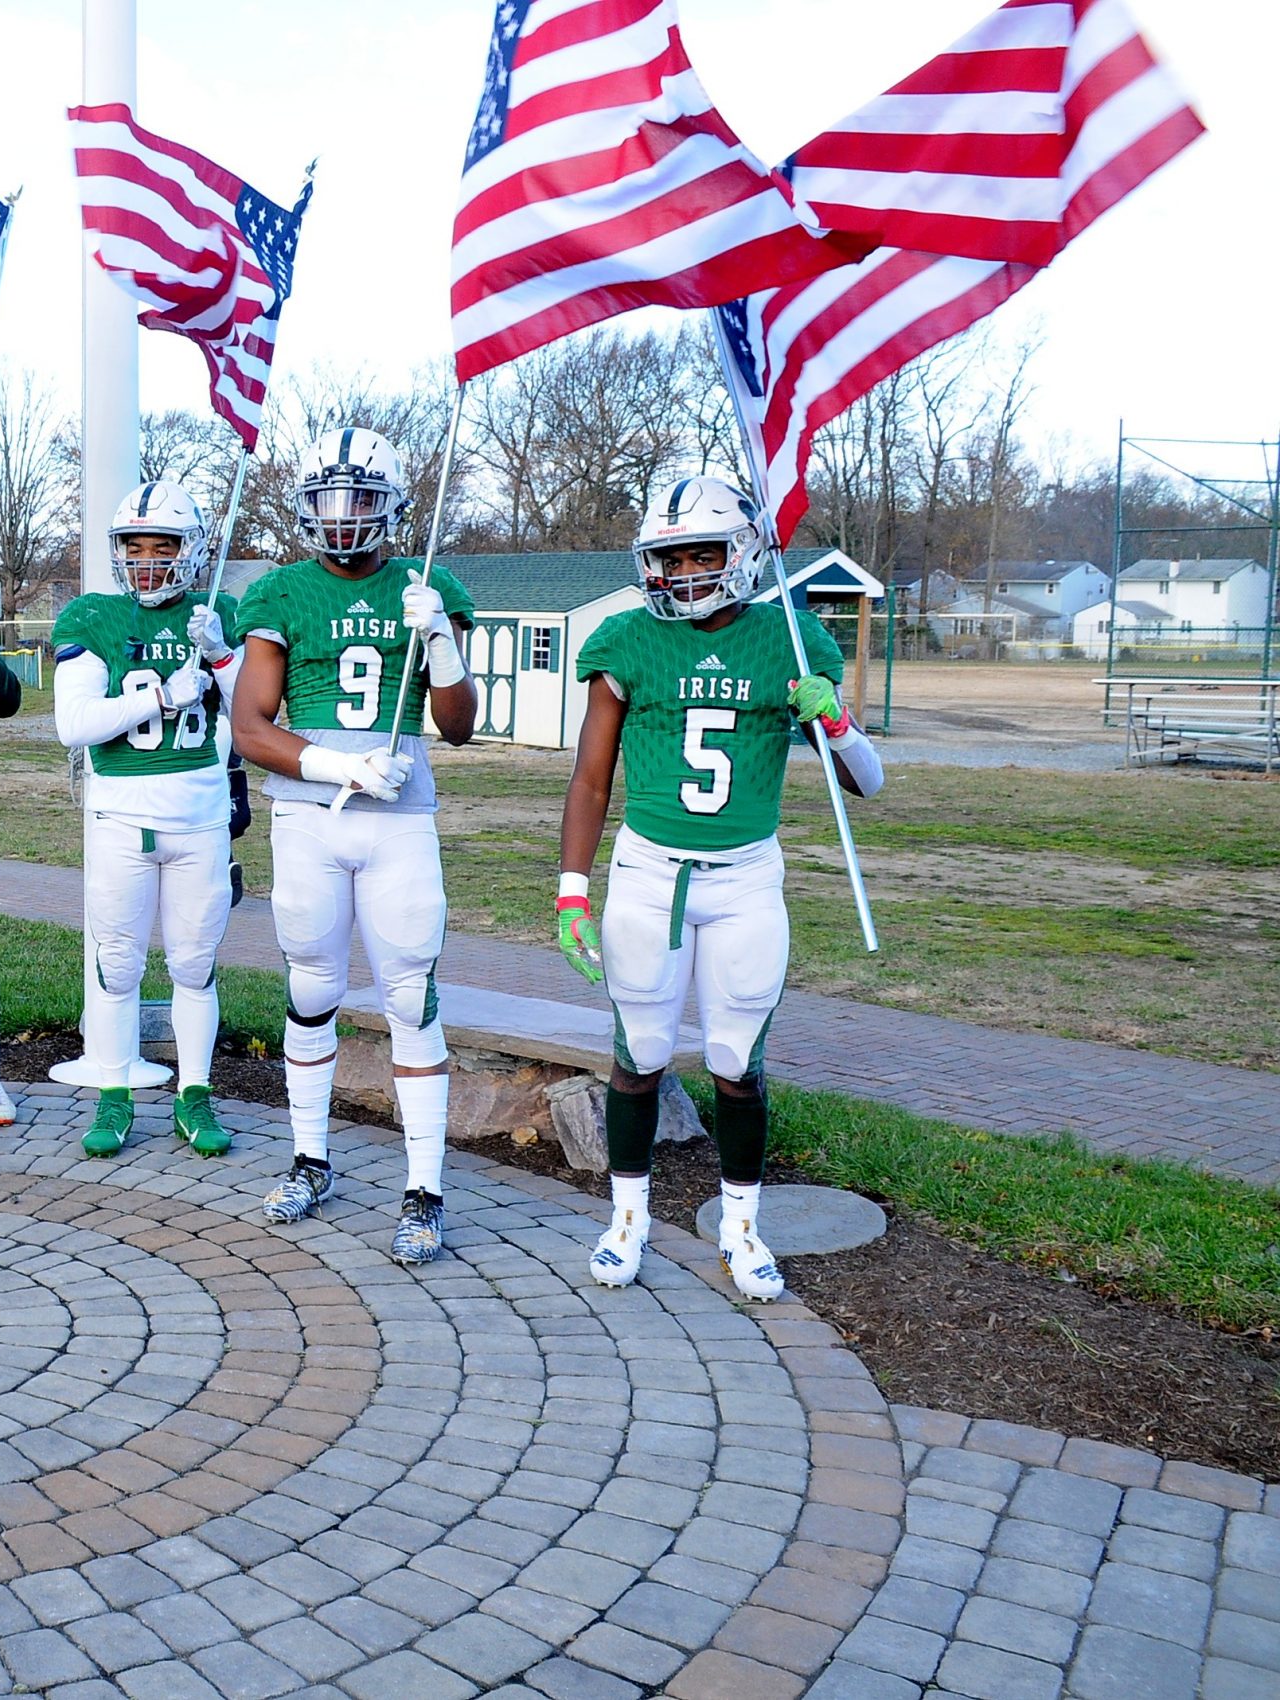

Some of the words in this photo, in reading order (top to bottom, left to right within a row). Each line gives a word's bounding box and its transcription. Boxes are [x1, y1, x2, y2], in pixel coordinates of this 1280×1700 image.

[346, 606, 375, 614] adidas
[330, 617, 398, 640] IRISH
[336, 645, 383, 729] 9
[678, 677, 752, 701] IRISH
[680, 707, 737, 814] 5
